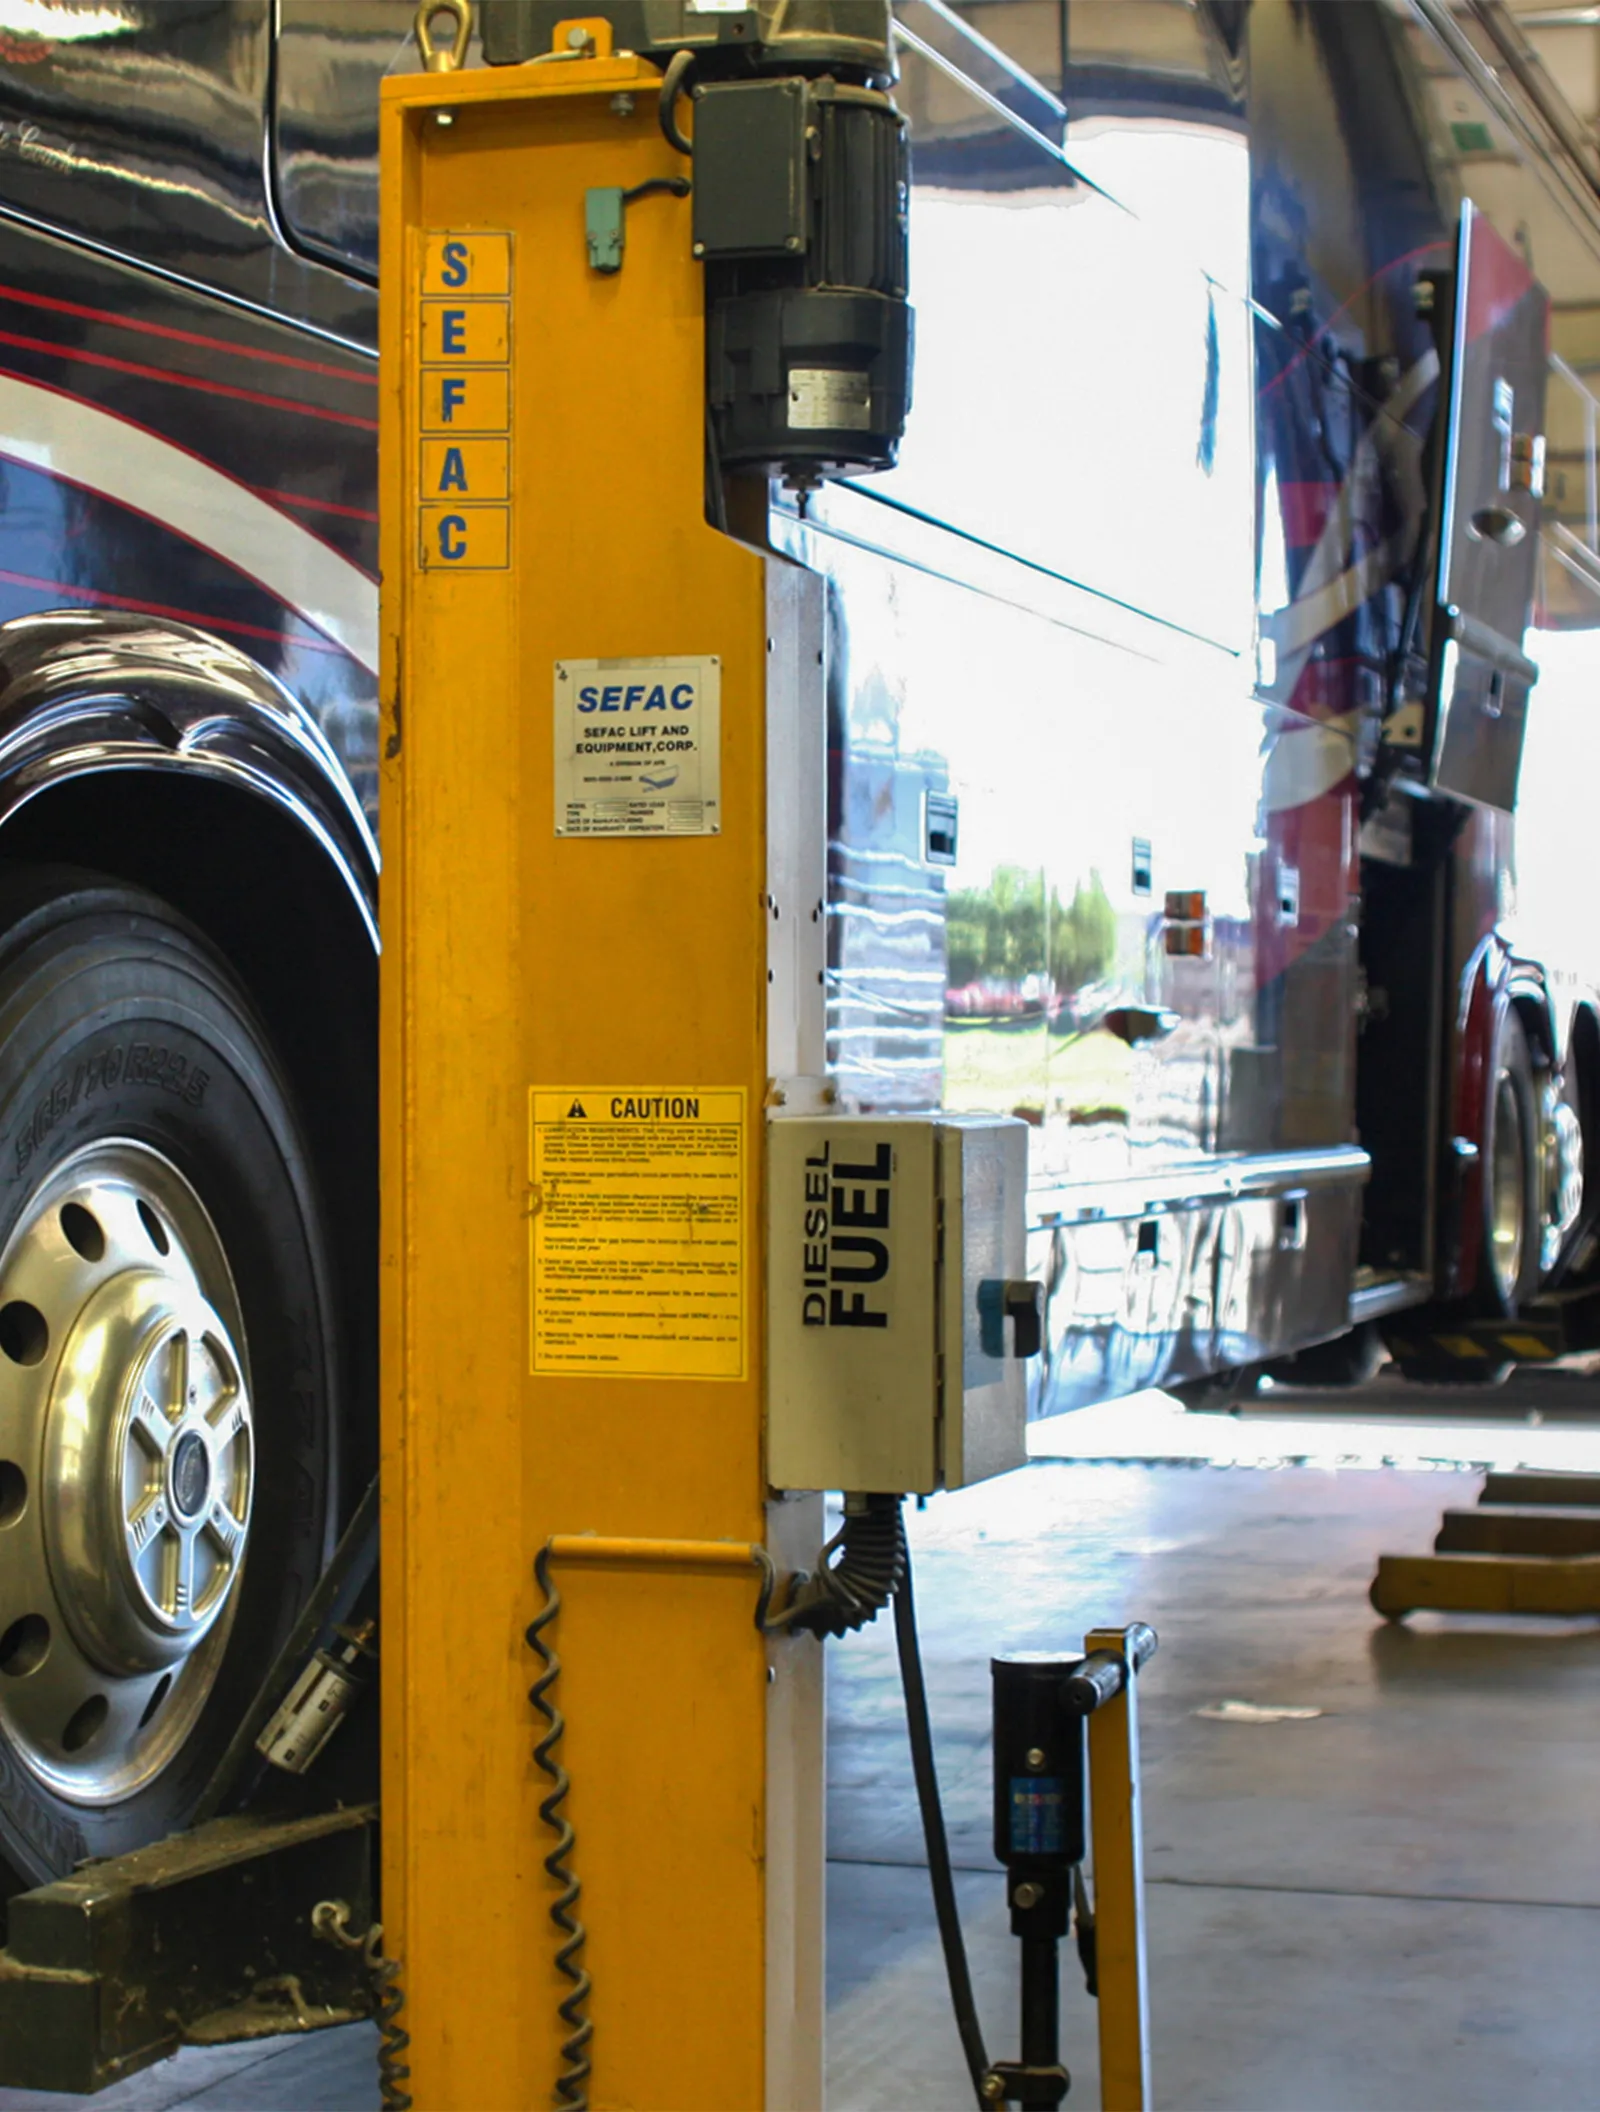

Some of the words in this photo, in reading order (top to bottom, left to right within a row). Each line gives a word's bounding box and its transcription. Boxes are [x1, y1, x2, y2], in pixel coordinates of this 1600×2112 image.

[438, 242, 468, 560] SEFAC
[577, 684, 694, 713] SEFAC
[584, 727, 626, 738] SEFAC
[629, 726, 657, 737] LIFT
[661, 725, 689, 736] AND
[611, 1097, 699, 1119] CAUTION
[803, 1140, 830, 1326] DIESEL
[829, 1143, 891, 1328] FUEL
